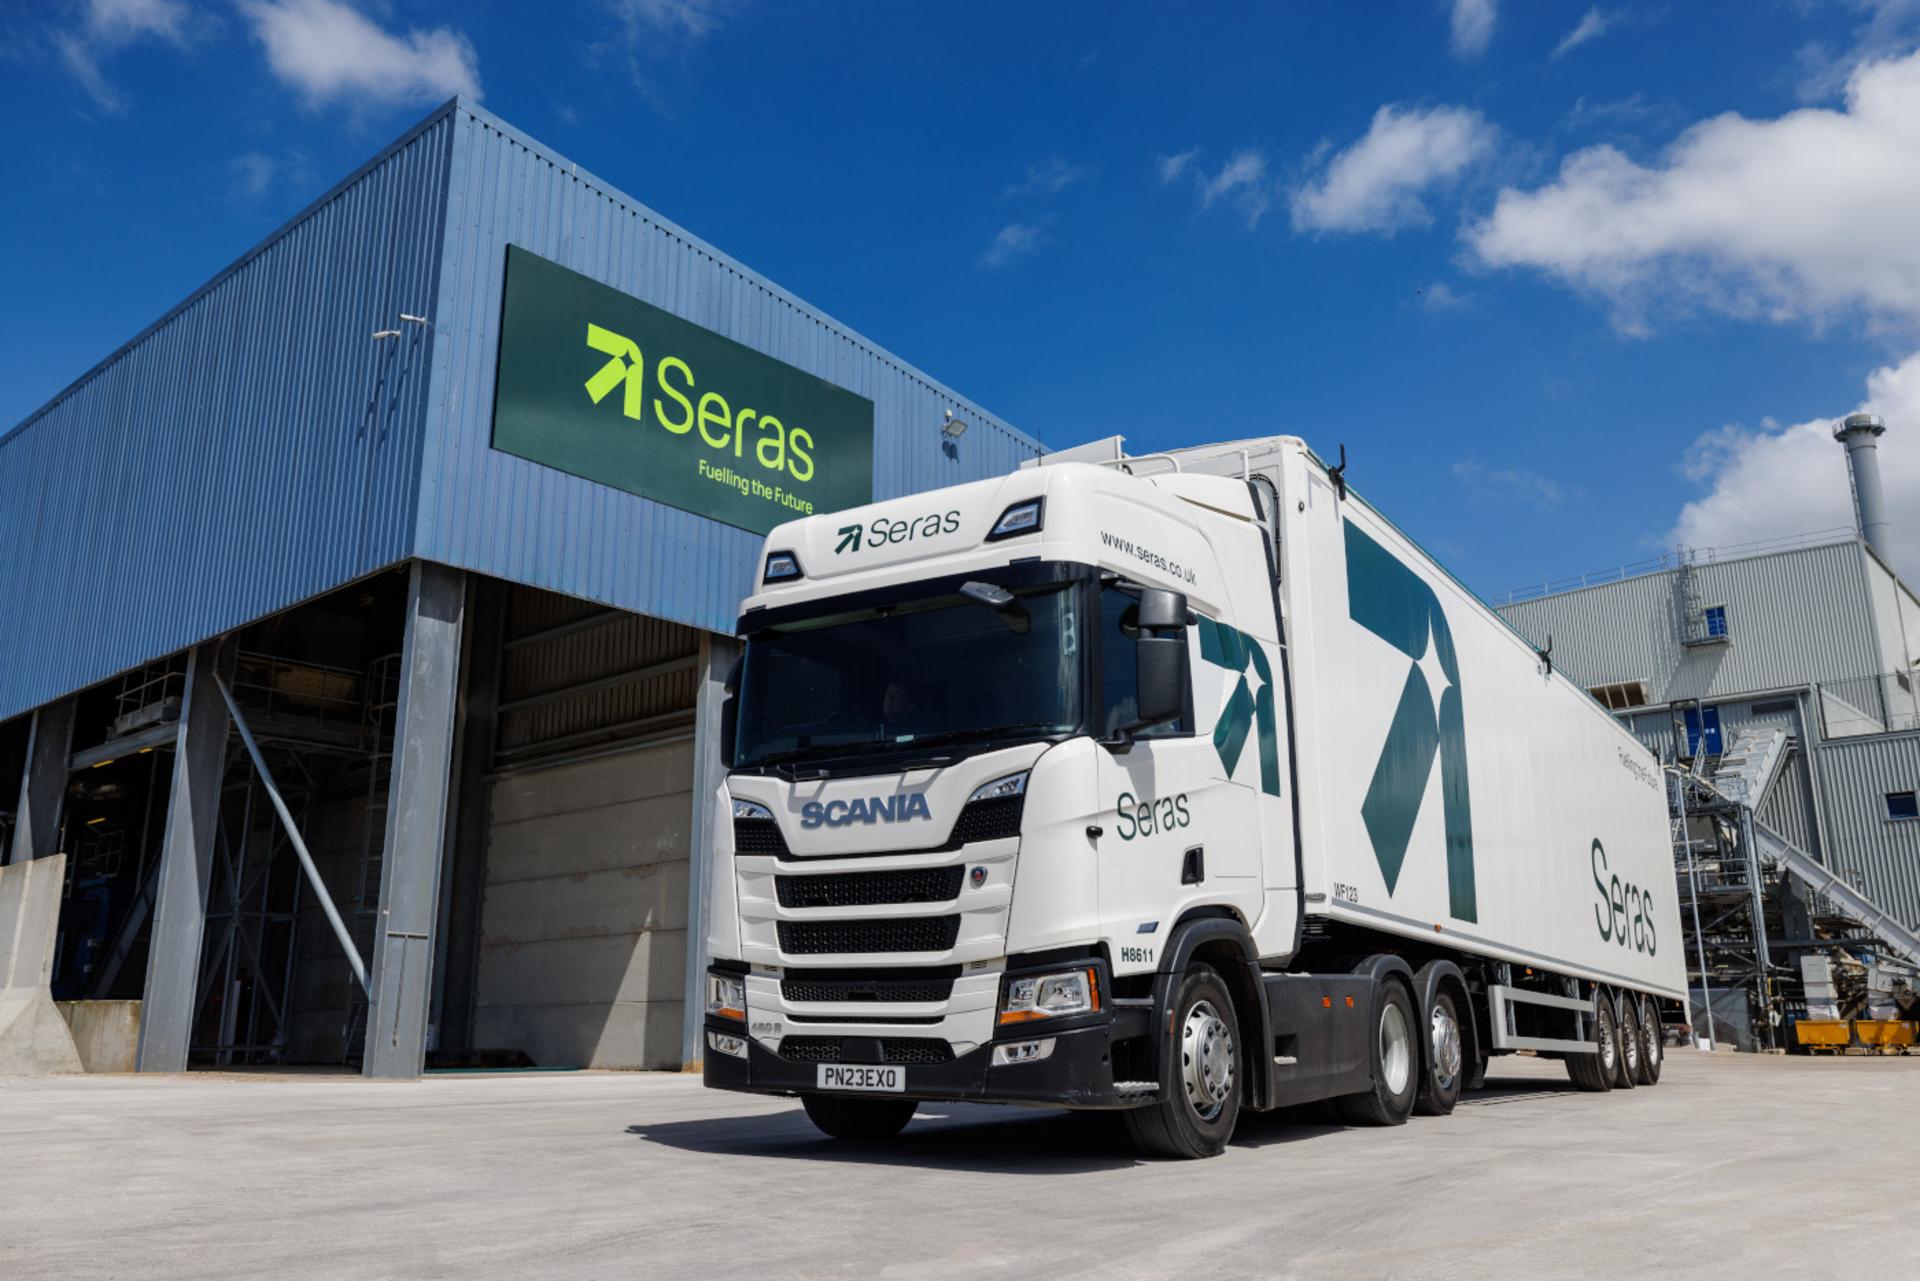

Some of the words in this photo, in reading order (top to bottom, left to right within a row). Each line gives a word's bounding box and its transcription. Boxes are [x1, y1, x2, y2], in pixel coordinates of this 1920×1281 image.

[654, 356, 815, 482] Seras
[698, 459, 749, 496] Fuelling
[751, 479, 773, 500] the
[774, 486, 814, 515] Future
[867, 510, 961, 548] Seras
[1100, 530, 1197, 586] www.seras.co.uk
[800, 792, 932, 829] SCANIA
[1117, 792, 1190, 841] Seras
[1333, 881, 1359, 903] WF123
[1591, 837, 1656, 957] Seras
[1121, 946, 1153, 962] H8611
